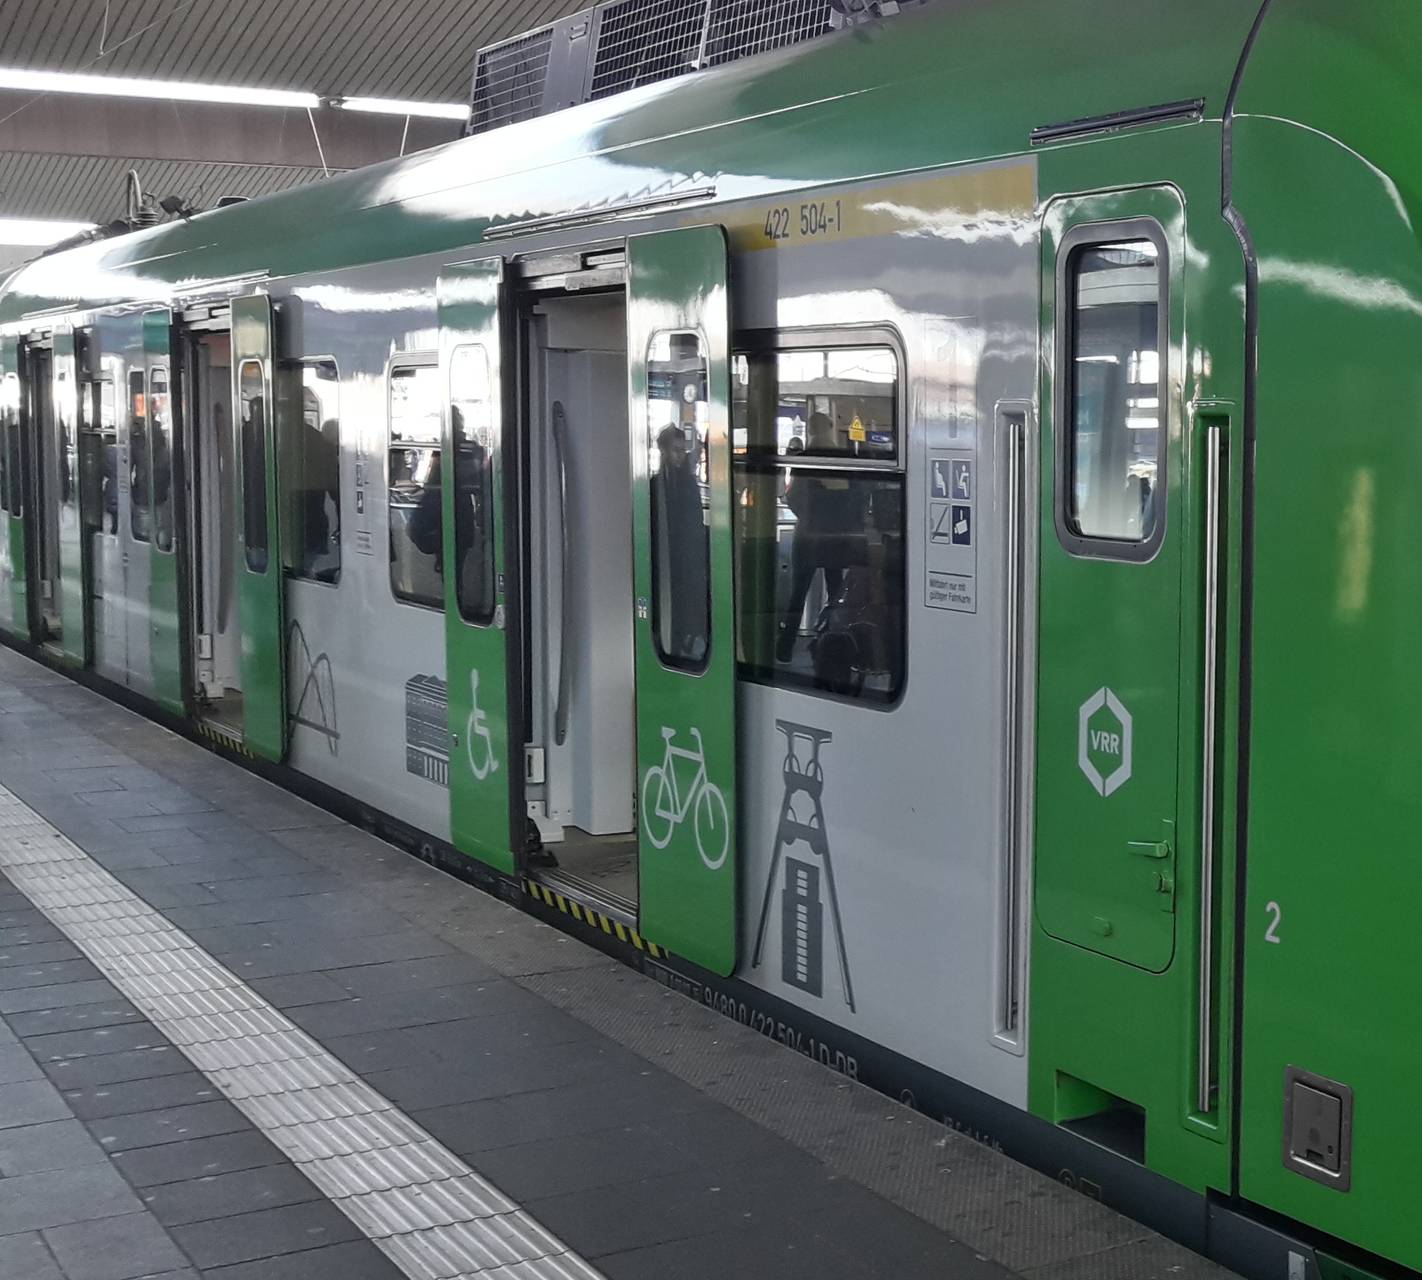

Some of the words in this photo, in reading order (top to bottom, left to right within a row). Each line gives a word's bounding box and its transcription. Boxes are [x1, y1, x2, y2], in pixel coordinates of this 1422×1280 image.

[764, 207, 790, 241] 422
[800, 200, 841, 236] 504-1
[1090, 729, 1120, 755] VRR
[1264, 900, 1281, 944] 2
